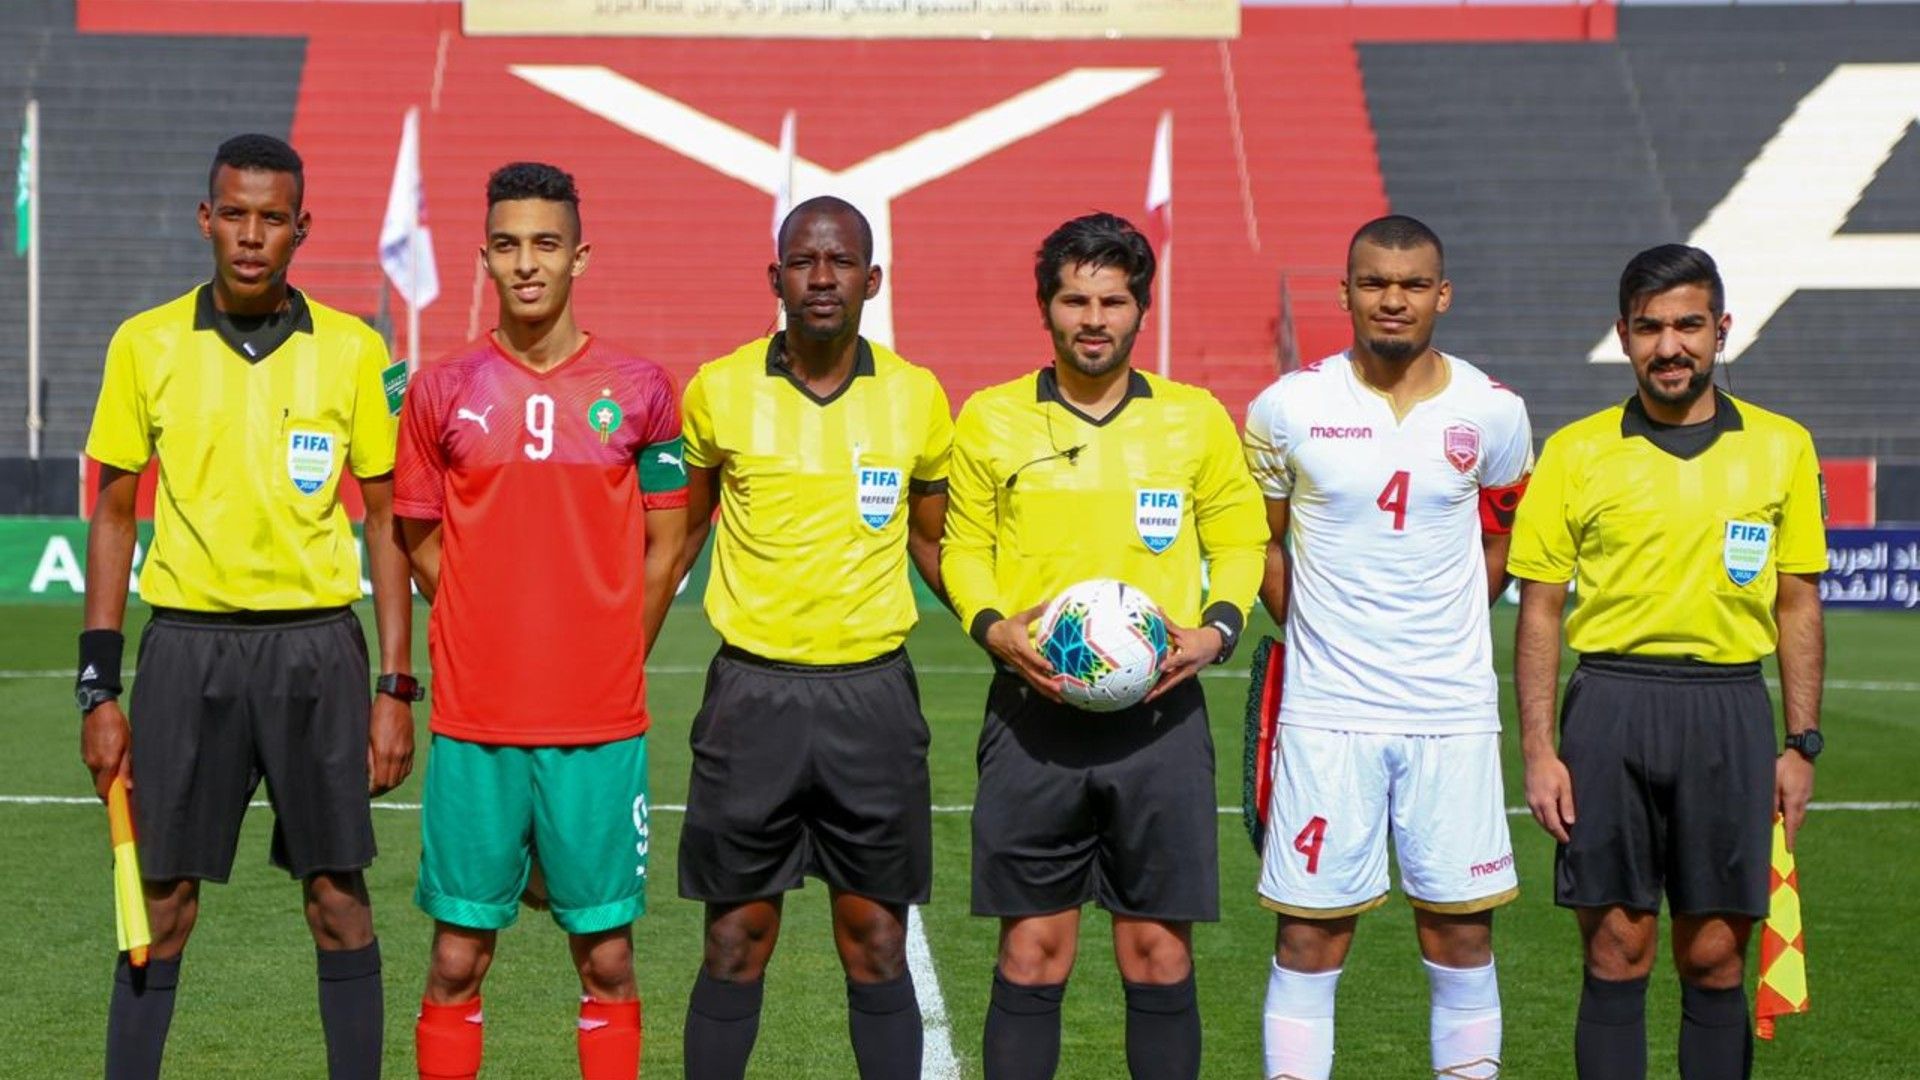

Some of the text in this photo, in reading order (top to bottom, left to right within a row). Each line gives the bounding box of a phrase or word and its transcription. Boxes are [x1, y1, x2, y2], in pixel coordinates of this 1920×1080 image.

[524, 393, 554, 460] 9
[1310, 426, 1373, 439] macron
[292, 434, 329, 452] FIFA
[861, 470, 898, 487] FIFA
[1140, 492, 1178, 508] FIFA
[1376, 470, 1410, 531] 4
[1140, 517, 1177, 526] REFEREE
[1730, 523, 1767, 543] FIFA
[1293, 815, 1328, 875] 4
